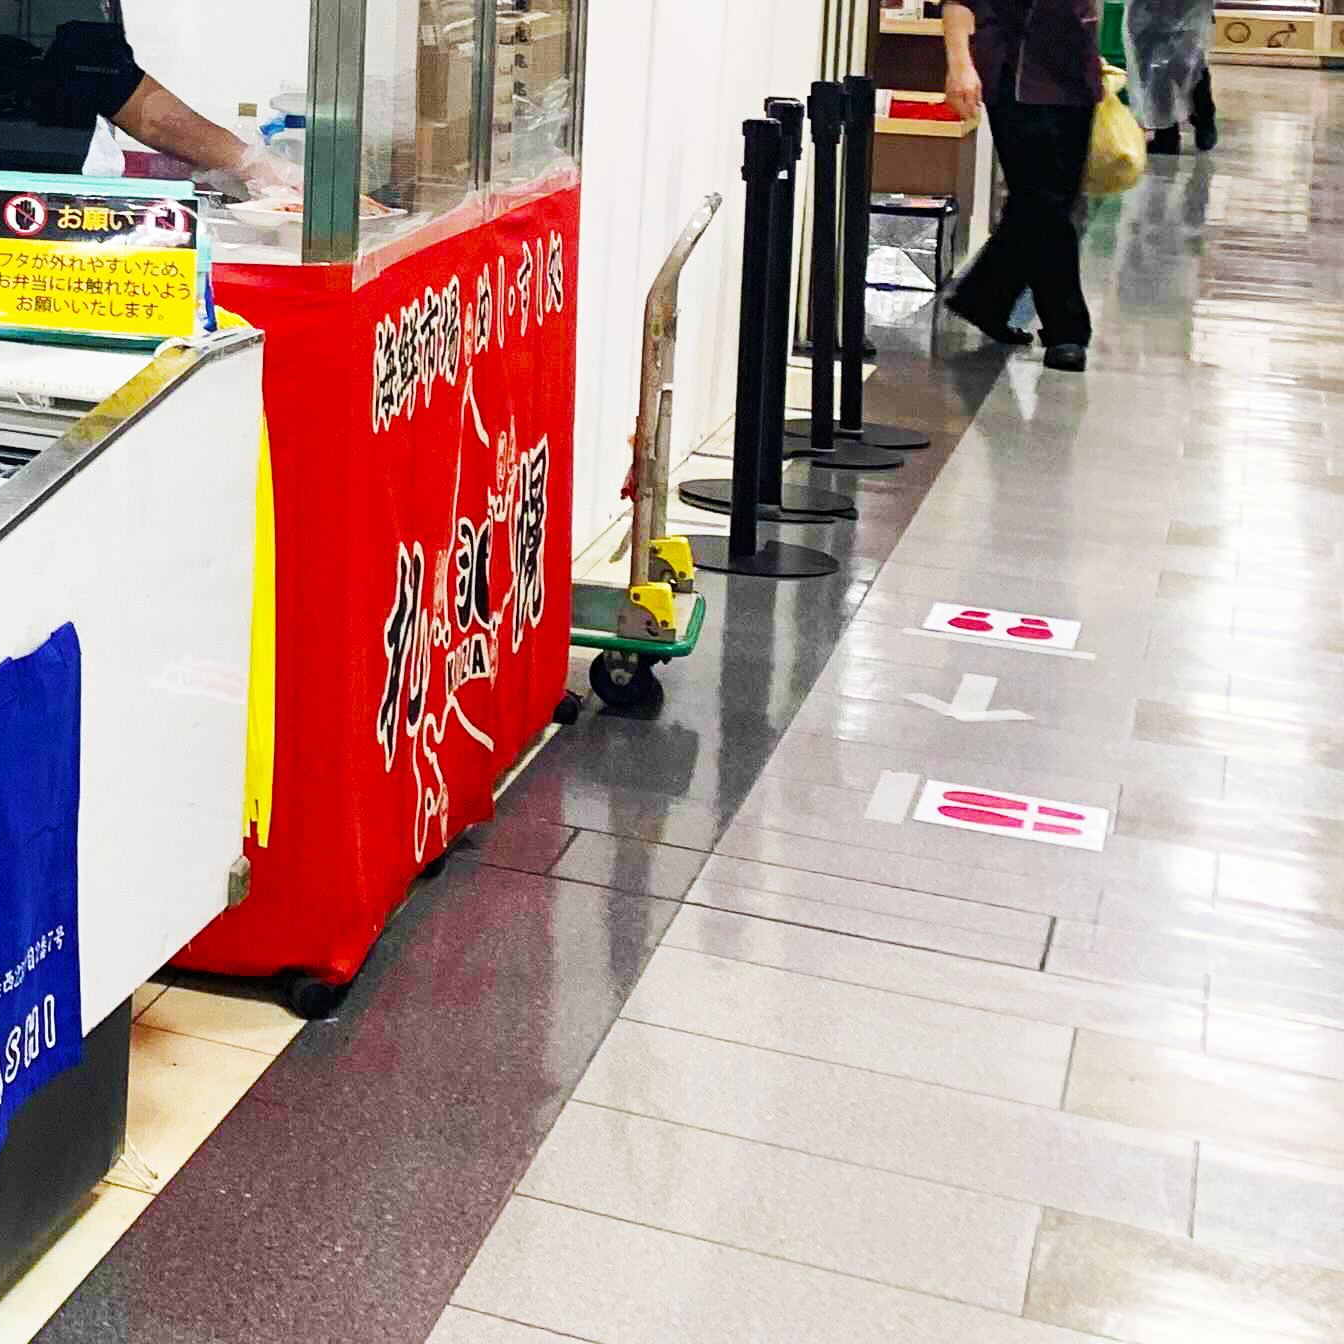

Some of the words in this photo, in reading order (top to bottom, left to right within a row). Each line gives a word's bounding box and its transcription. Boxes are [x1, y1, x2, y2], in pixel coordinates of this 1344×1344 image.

[57, 205, 135, 233] お願い
[0, 251, 186, 279] フタが外れやすいため、
[16, 295, 165, 321] お願いいたします。
